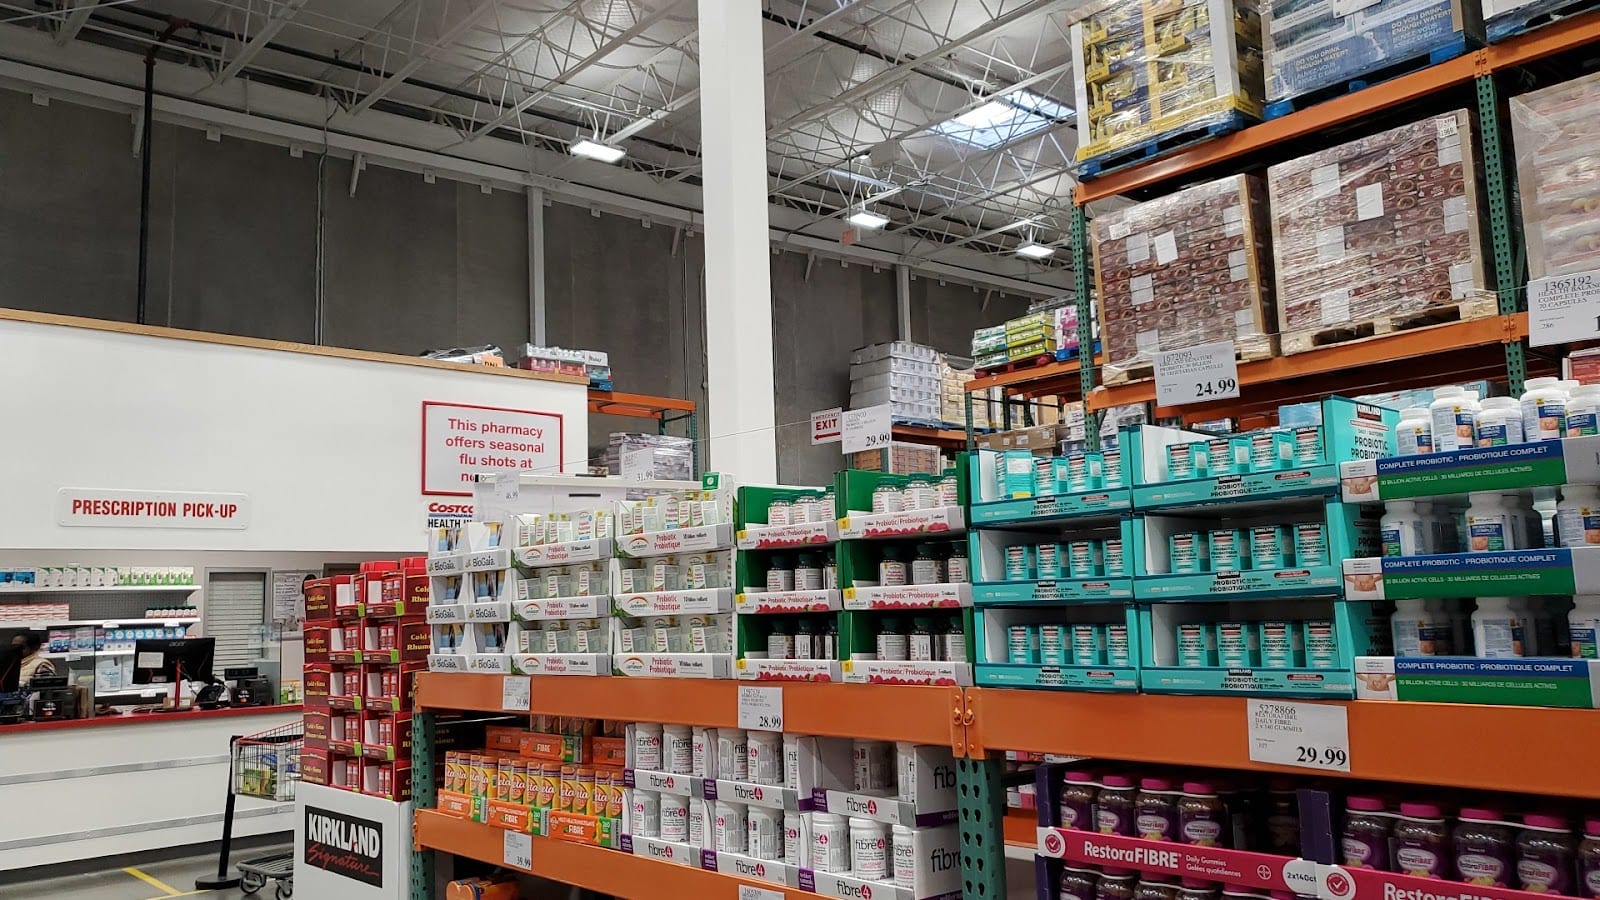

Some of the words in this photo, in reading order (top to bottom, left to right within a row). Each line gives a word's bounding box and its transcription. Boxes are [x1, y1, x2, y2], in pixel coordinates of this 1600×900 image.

[1402, 14, 1419, 26] YOU
[1545, 275, 1592, 292] 1365192
[1538, 286, 1569, 298] HEALTH
[1538, 292, 1580, 304] COMPLETE
[1548, 298, 1587, 308] CAPSULES
[1167, 367, 1198, 376] VEGETARIAN
[1198, 362, 1224, 371] CAPSULES
[1195, 378, 1236, 397] 24.99
[1357, 404, 1380, 415] KIRKLAND
[448, 418, 477, 432] This
[481, 421, 543, 439] pharmacy
[815, 418, 838, 431] EXIT
[445, 436, 485, 449] offers
[489, 438, 544, 453] seasonal
[865, 432, 890, 447] 29.99
[1354, 436, 1388, 450] PROBIOTIC
[459, 453, 477, 466] flu
[481, 455, 516, 468] shots
[520, 457, 533, 469] at
[1379, 461, 1415, 470] COMPLETE
[1416, 456, 1454, 466] PROBIOTIC
[1459, 450, 1509, 462] PROBIOTIQUE
[1510, 446, 1548, 456] COMPLET
[1210, 488, 1252, 497] PROBIOTIQUE
[1213, 482, 1247, 491] PROBIOTIC
[72, 499, 177, 517] PRESCRIPTION
[182, 503, 238, 518] PICK-UP
[428, 519, 461, 529] HEALTH
[656, 534, 676, 542] Probiotic
[654, 542, 680, 551] Probiotique
[434, 560, 456, 571] BioGaia
[472, 555, 496, 567] BioGaia
[1384, 559, 1421, 568] COMPLETE
[1422, 558, 1460, 566] PROBIOTIC
[1465, 555, 1517, 565] PROBIOTIQUE
[1518, 554, 1557, 563] COMPLET
[1212, 578, 1247, 586] PROBIOTIC
[1210, 585, 1251, 593] PROBIOTIQUE
[656, 595, 677, 603] Probiotic
[434, 608, 456, 618] BioGaia
[475, 607, 497, 618] BioGaia
[653, 603, 680, 612] Probiotique
[478, 656, 500, 669] BioGaia
[652, 657, 672, 665] Probiotic
[1397, 662, 1434, 670] COMPLETE
[1436, 662, 1475, 670] PROBIOTIC
[1480, 663, 1533, 671] PROBIOTIQUE
[1534, 664, 1573, 672] COMPLET
[650, 666, 676, 676] Probiotique
[1259, 703, 1296, 715] 5278866
[759, 715, 782, 729] 28.99
[1274, 725, 1303, 733] GUMMIES
[537, 744, 551, 752] FIBRE
[1296, 745, 1347, 766] 29.99
[504, 814, 518, 823] FIBRE
[308, 813, 380, 859] KIRKLAND
[569, 825, 584, 835] FIBRE
[307, 845, 379, 877] Signature
[1084, 841, 1180, 870] RestoraFIBRE
[1186, 854, 1201, 864] Daily
[1201, 856, 1227, 867] Gummies
[1206, 867, 1242, 878] quotidiennes
